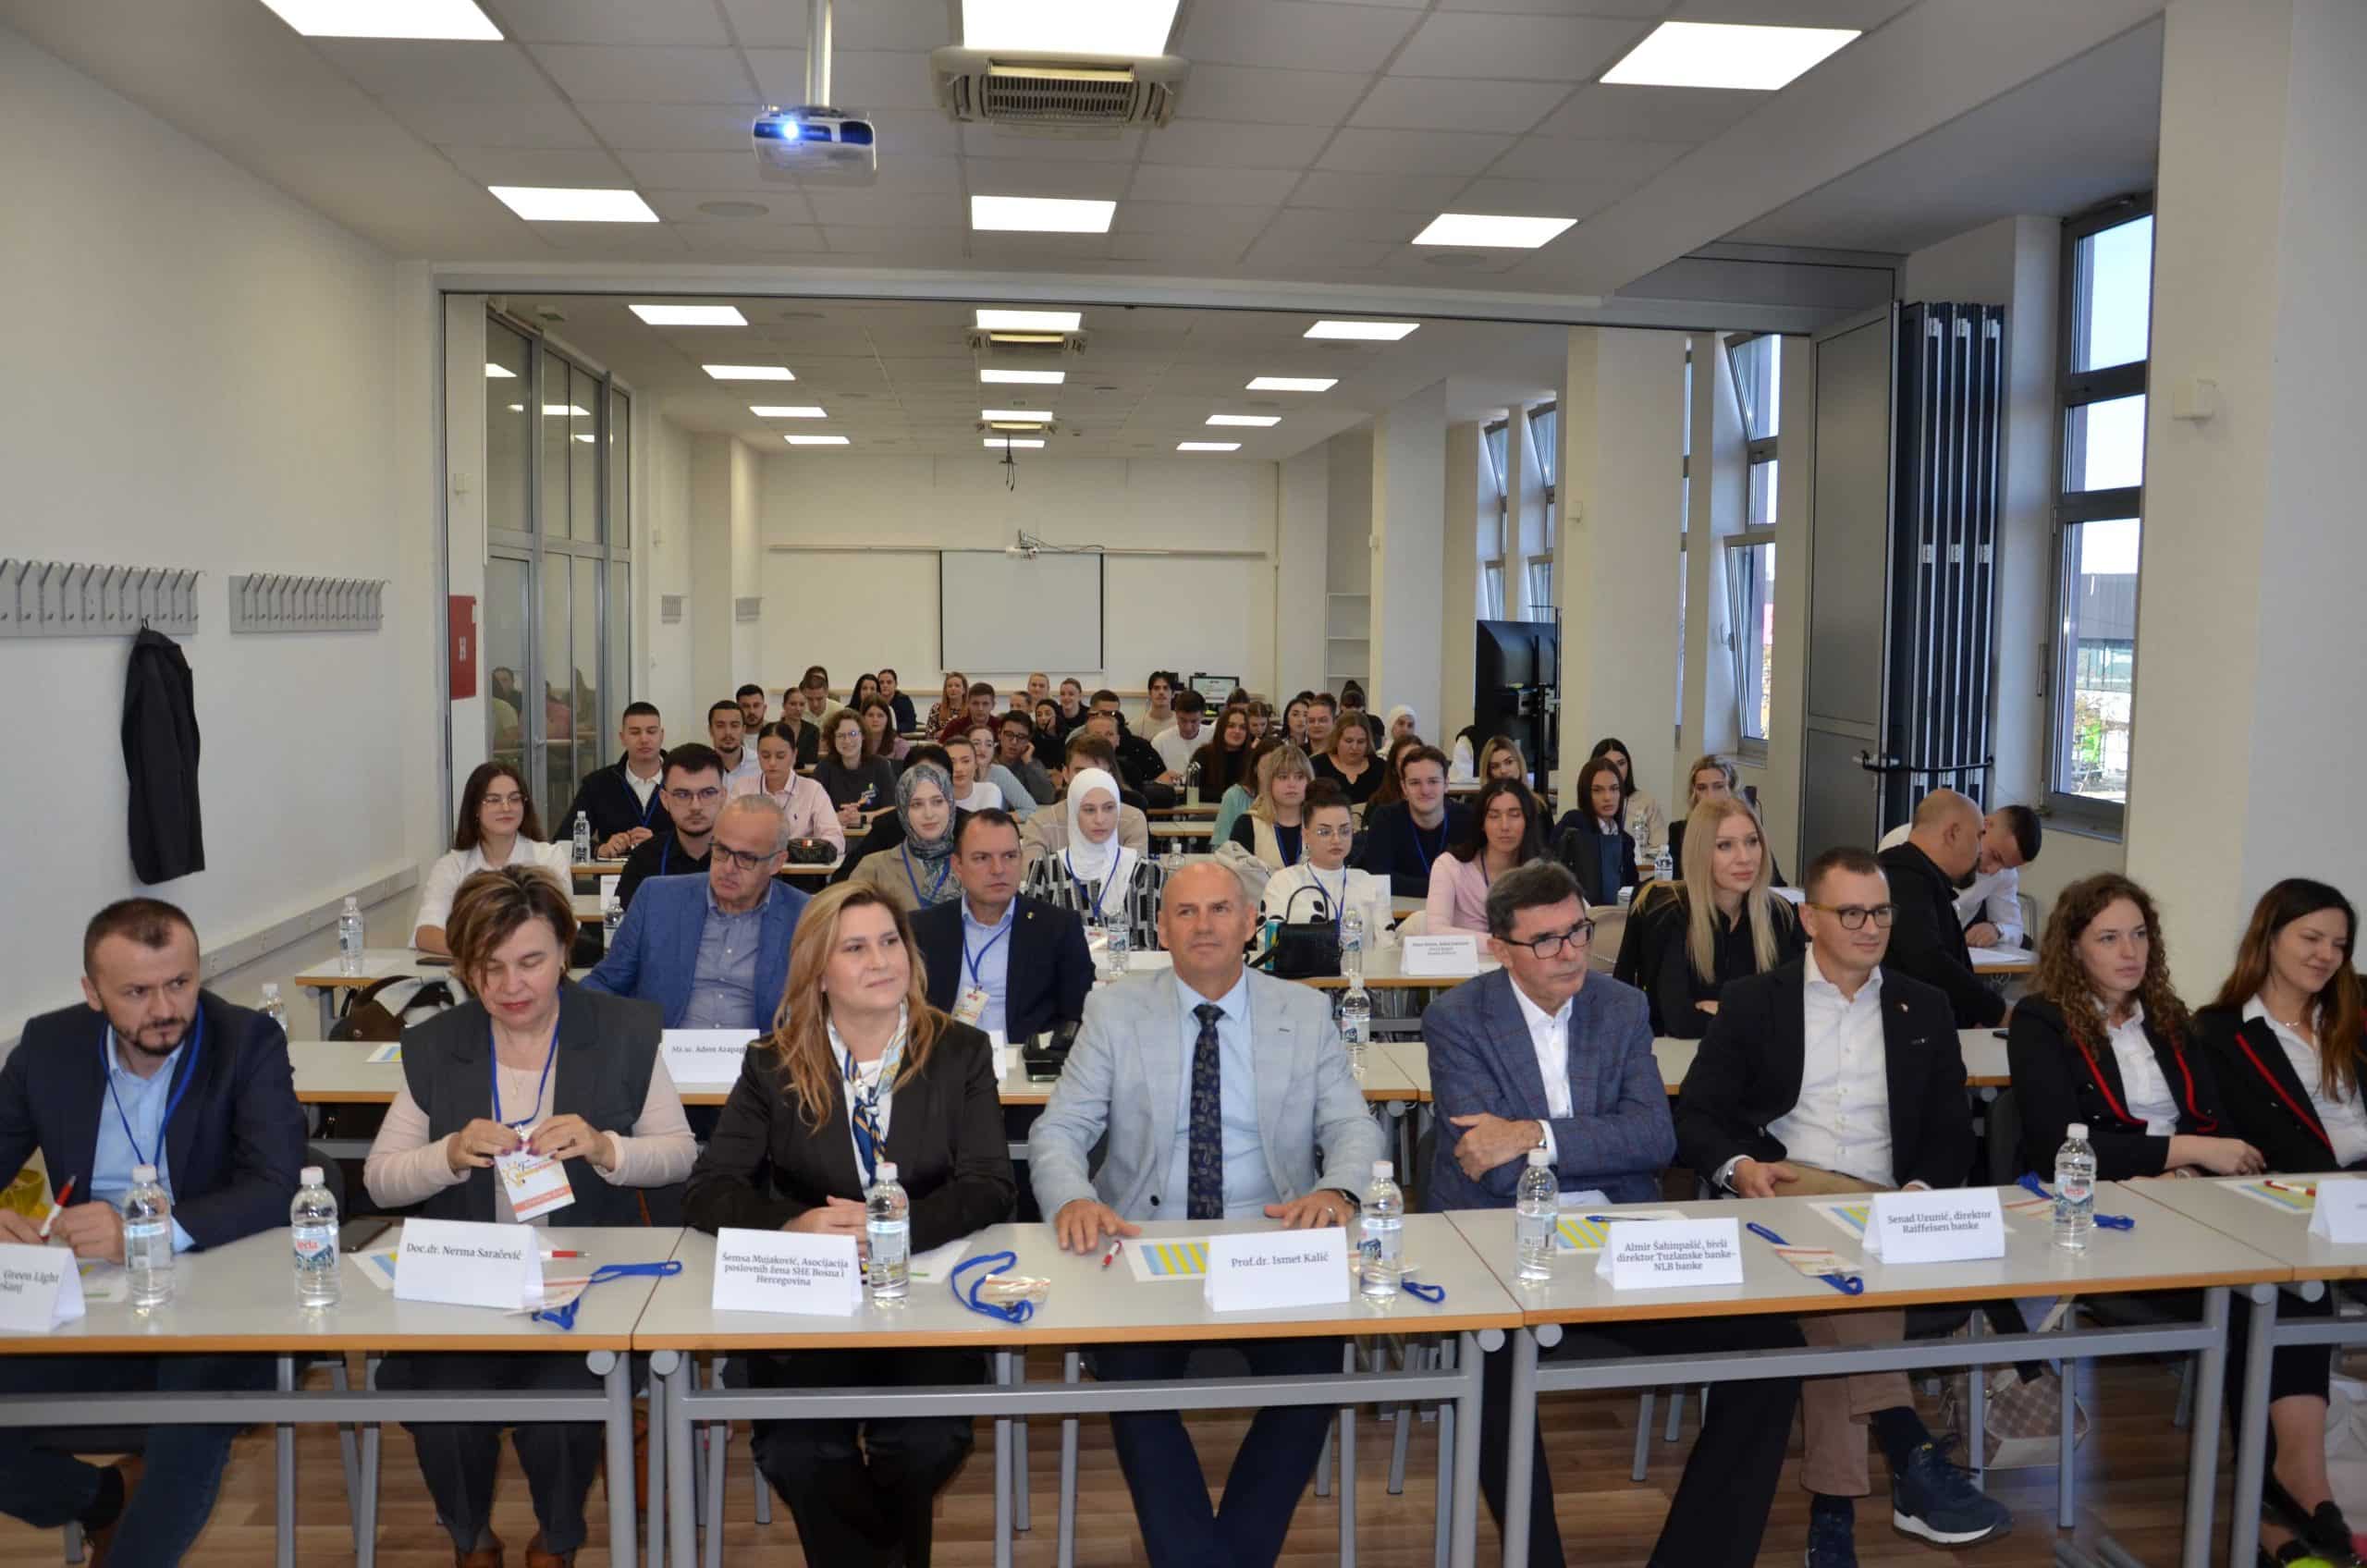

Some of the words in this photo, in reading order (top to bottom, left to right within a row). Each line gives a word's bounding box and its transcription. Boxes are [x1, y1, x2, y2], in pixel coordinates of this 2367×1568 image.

[1887, 1212, 1915, 1224] Senad
[1954, 1208, 1991, 1220] direktor
[1903, 1220, 1950, 1234] Raiffeisen
[1951, 1219, 1980, 1231] banke
[443, 1245, 475, 1257] Nerma
[476, 1247, 521, 1261] Saračević
[1625, 1242, 1651, 1252] Almir
[802, 1257, 849, 1269] Asocijacija
[1271, 1254, 1302, 1266] Ismet
[1616, 1252, 1655, 1263] direktor
[1656, 1250, 1703, 1261] Tuzlanske
[724, 1263, 769, 1274] poslovnih
[769, 1265, 791, 1275] žena
[812, 1268, 840, 1278] Bosna
[1653, 1262, 1674, 1271] NLB
[1675, 1260, 1703, 1270] banke
[755, 1273, 811, 1287] Hercegovina
